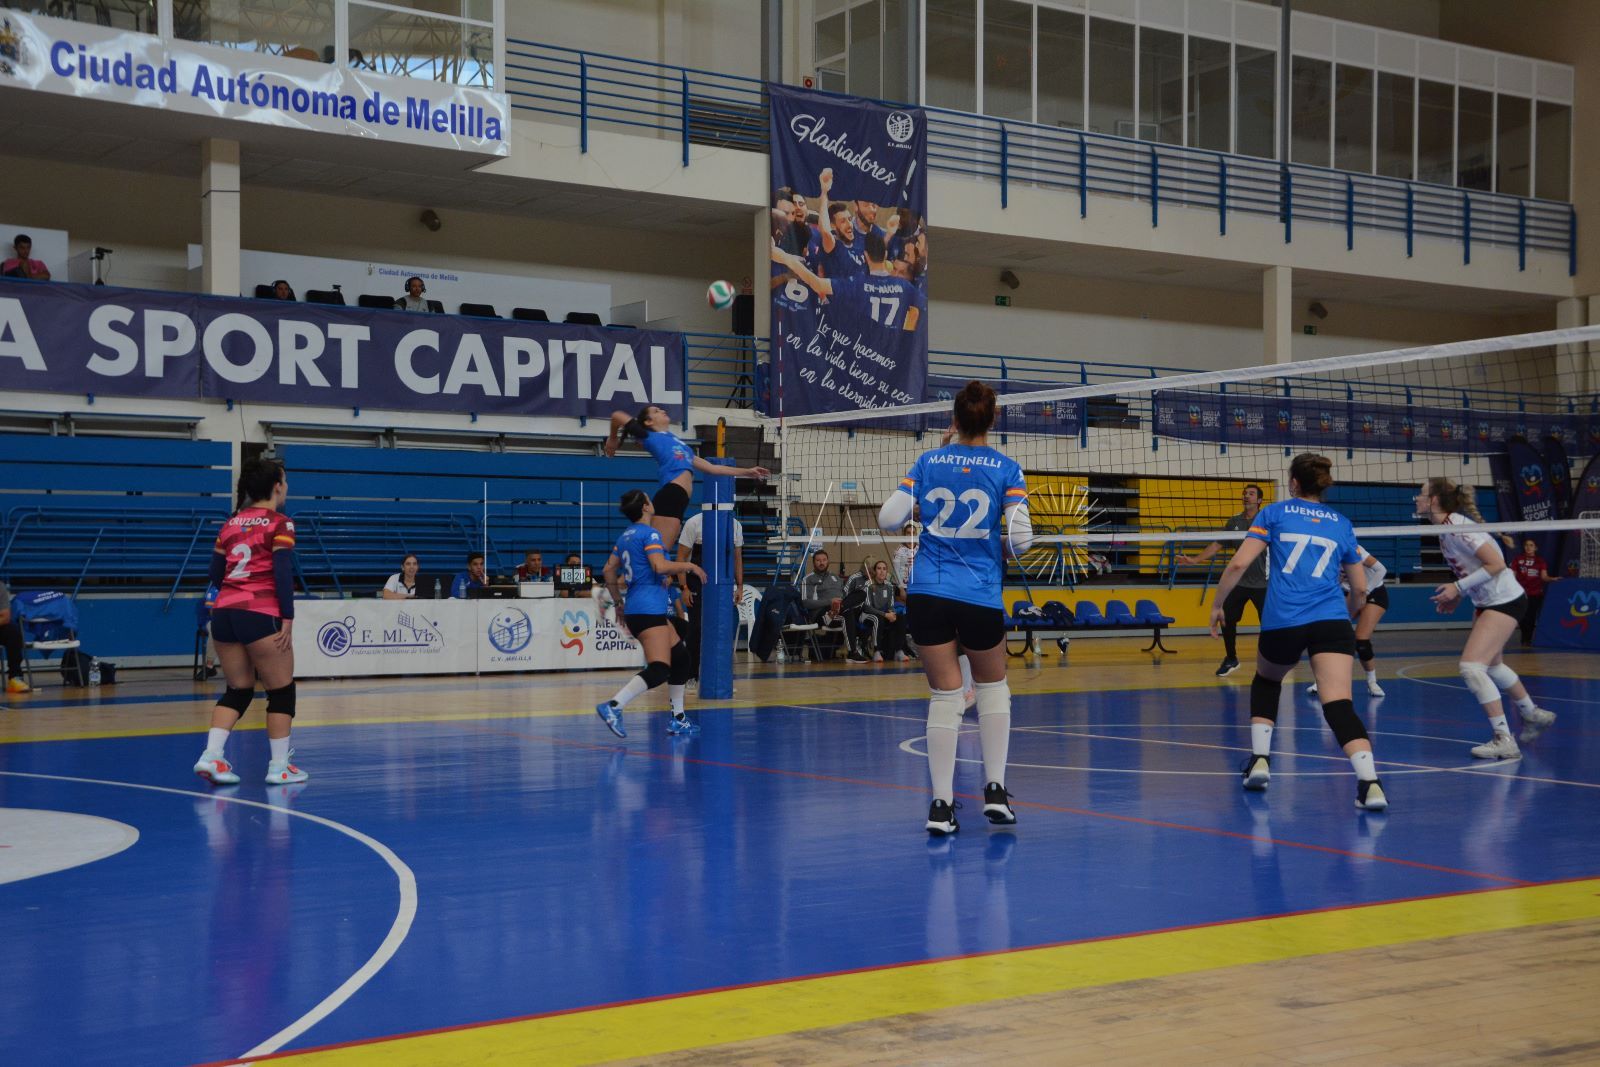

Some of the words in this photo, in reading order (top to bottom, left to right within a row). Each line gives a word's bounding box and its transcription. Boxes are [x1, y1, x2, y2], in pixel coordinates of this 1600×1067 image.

[51, 40, 177, 94] Ciudad
[191, 64, 357, 120] Autónoma
[363, 91, 400, 125] de
[406, 96, 502, 141] Melilla
[790, 113, 897, 186] Gladiadores
[378, 268, 399, 276] Ciudad
[431, 272, 438, 280] de
[439, 273, 458, 282] Melilla
[785, 278, 809, 303] 6
[869, 296, 900, 326] 17
[86, 304, 371, 389] SPORT
[394, 329, 683, 404] CAPITAL
[832, 329, 851, 350] que
[853, 333, 896, 370] hacemos
[786, 333, 802, 350] en
[806, 334, 822, 357] la
[825, 350, 846, 371] vida
[849, 360, 877, 386] tiene
[878, 381, 888, 395] su
[891, 388, 914, 404] eco
[800, 367, 817, 384] en
[821, 367, 836, 391] la
[927, 454, 1002, 468] MARTINELLI
[228, 517, 271, 527] CRUZADO
[924, 486, 991, 540] 22
[1284, 504, 1339, 522] LUENGAS
[227, 543, 252, 579] 2
[621, 550, 633, 582] 3
[1279, 532, 1338, 578] 77
[563, 571, 571, 581] 18
[574, 571, 585, 581] 20
[361, 629, 374, 643] F.
